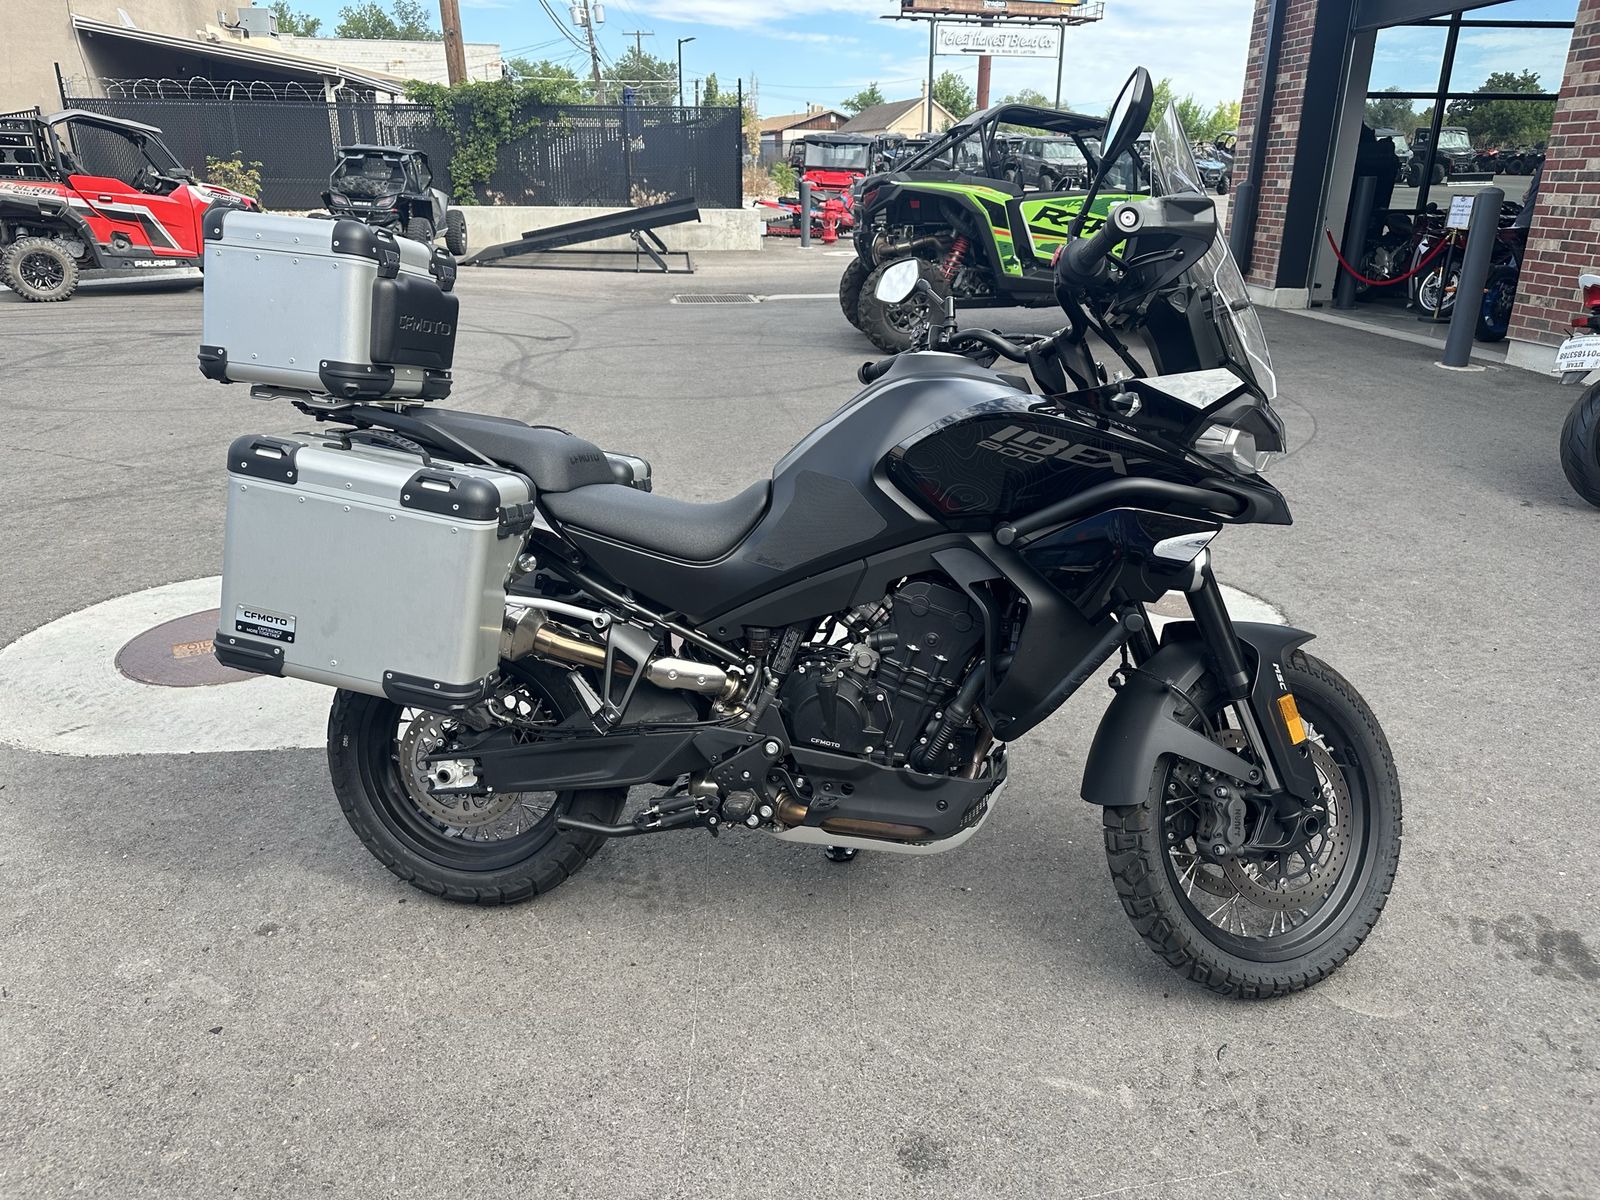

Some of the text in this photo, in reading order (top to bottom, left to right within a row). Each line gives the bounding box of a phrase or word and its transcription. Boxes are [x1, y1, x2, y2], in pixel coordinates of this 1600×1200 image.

[134, 259, 177, 268] POLARIS
[400, 315, 451, 336] CFMOTO
[976, 440, 1046, 464] 800
[988, 424, 1153, 476] IBEX
[244, 610, 288, 626] CFMOTO
[246, 627, 281, 639] MORE TOGETHER
[1272, 663, 1287, 691] MSC
[810, 737, 841, 749] CFMOTO
